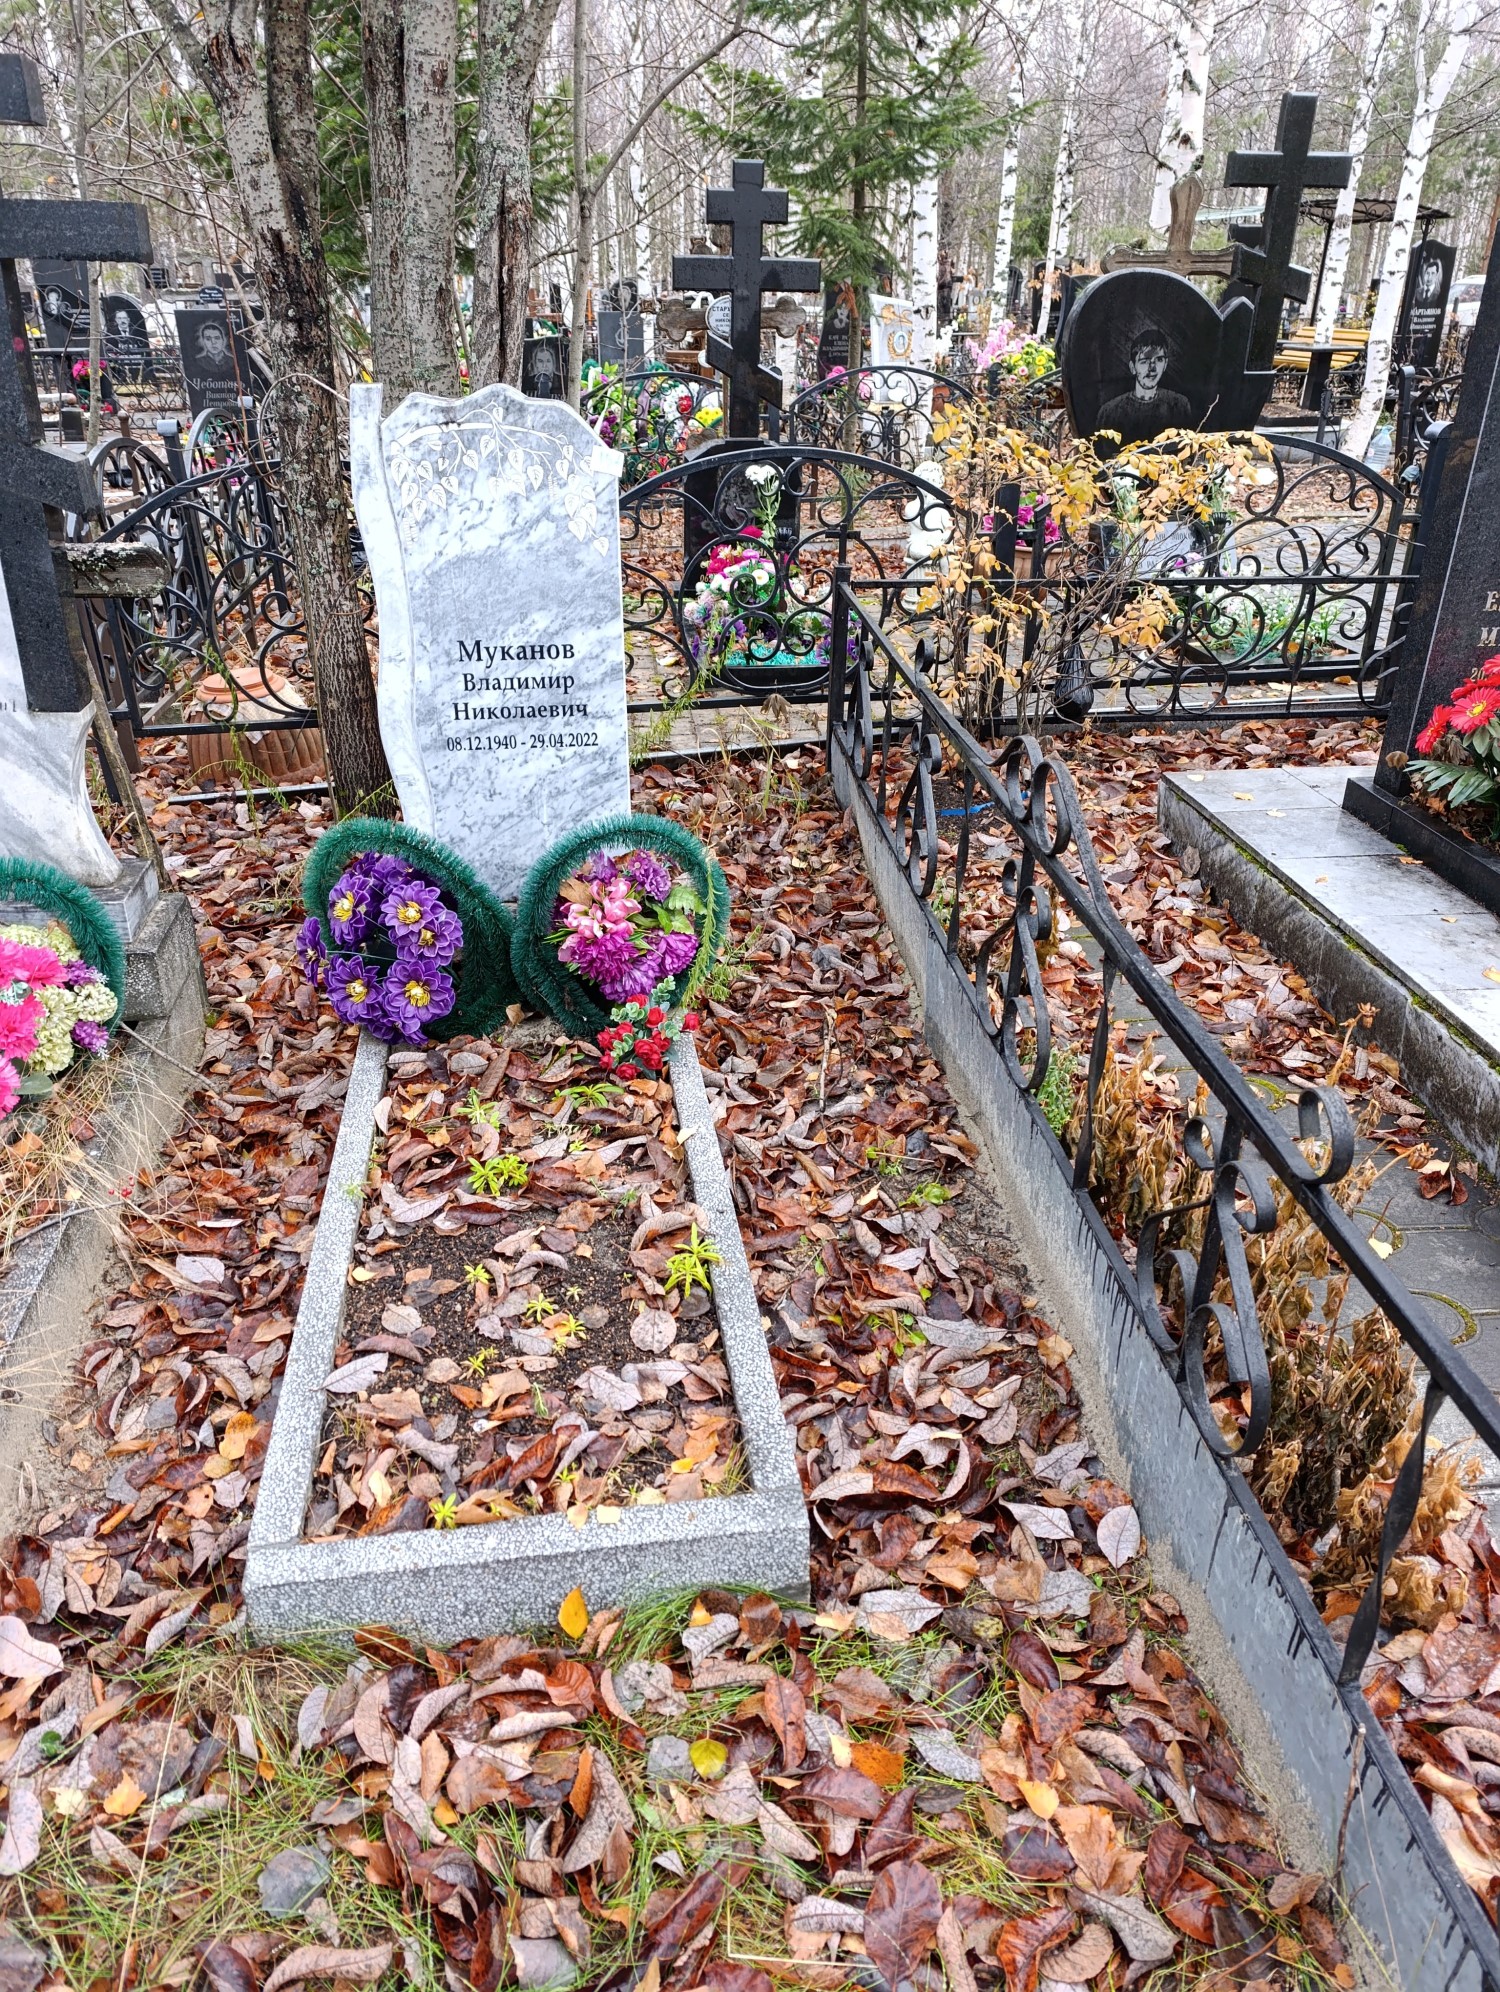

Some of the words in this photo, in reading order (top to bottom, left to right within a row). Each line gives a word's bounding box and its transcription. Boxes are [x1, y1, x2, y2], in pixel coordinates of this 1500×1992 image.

[205, 390, 237, 400] Виктор
[457, 639, 576, 669] Муканов
[462, 672, 576, 695] Владимир
[452, 702, 589, 721] Николаевич
[446, 735, 517, 752] 08.12.1940
[529, 732, 599, 750] 29.04.2022
